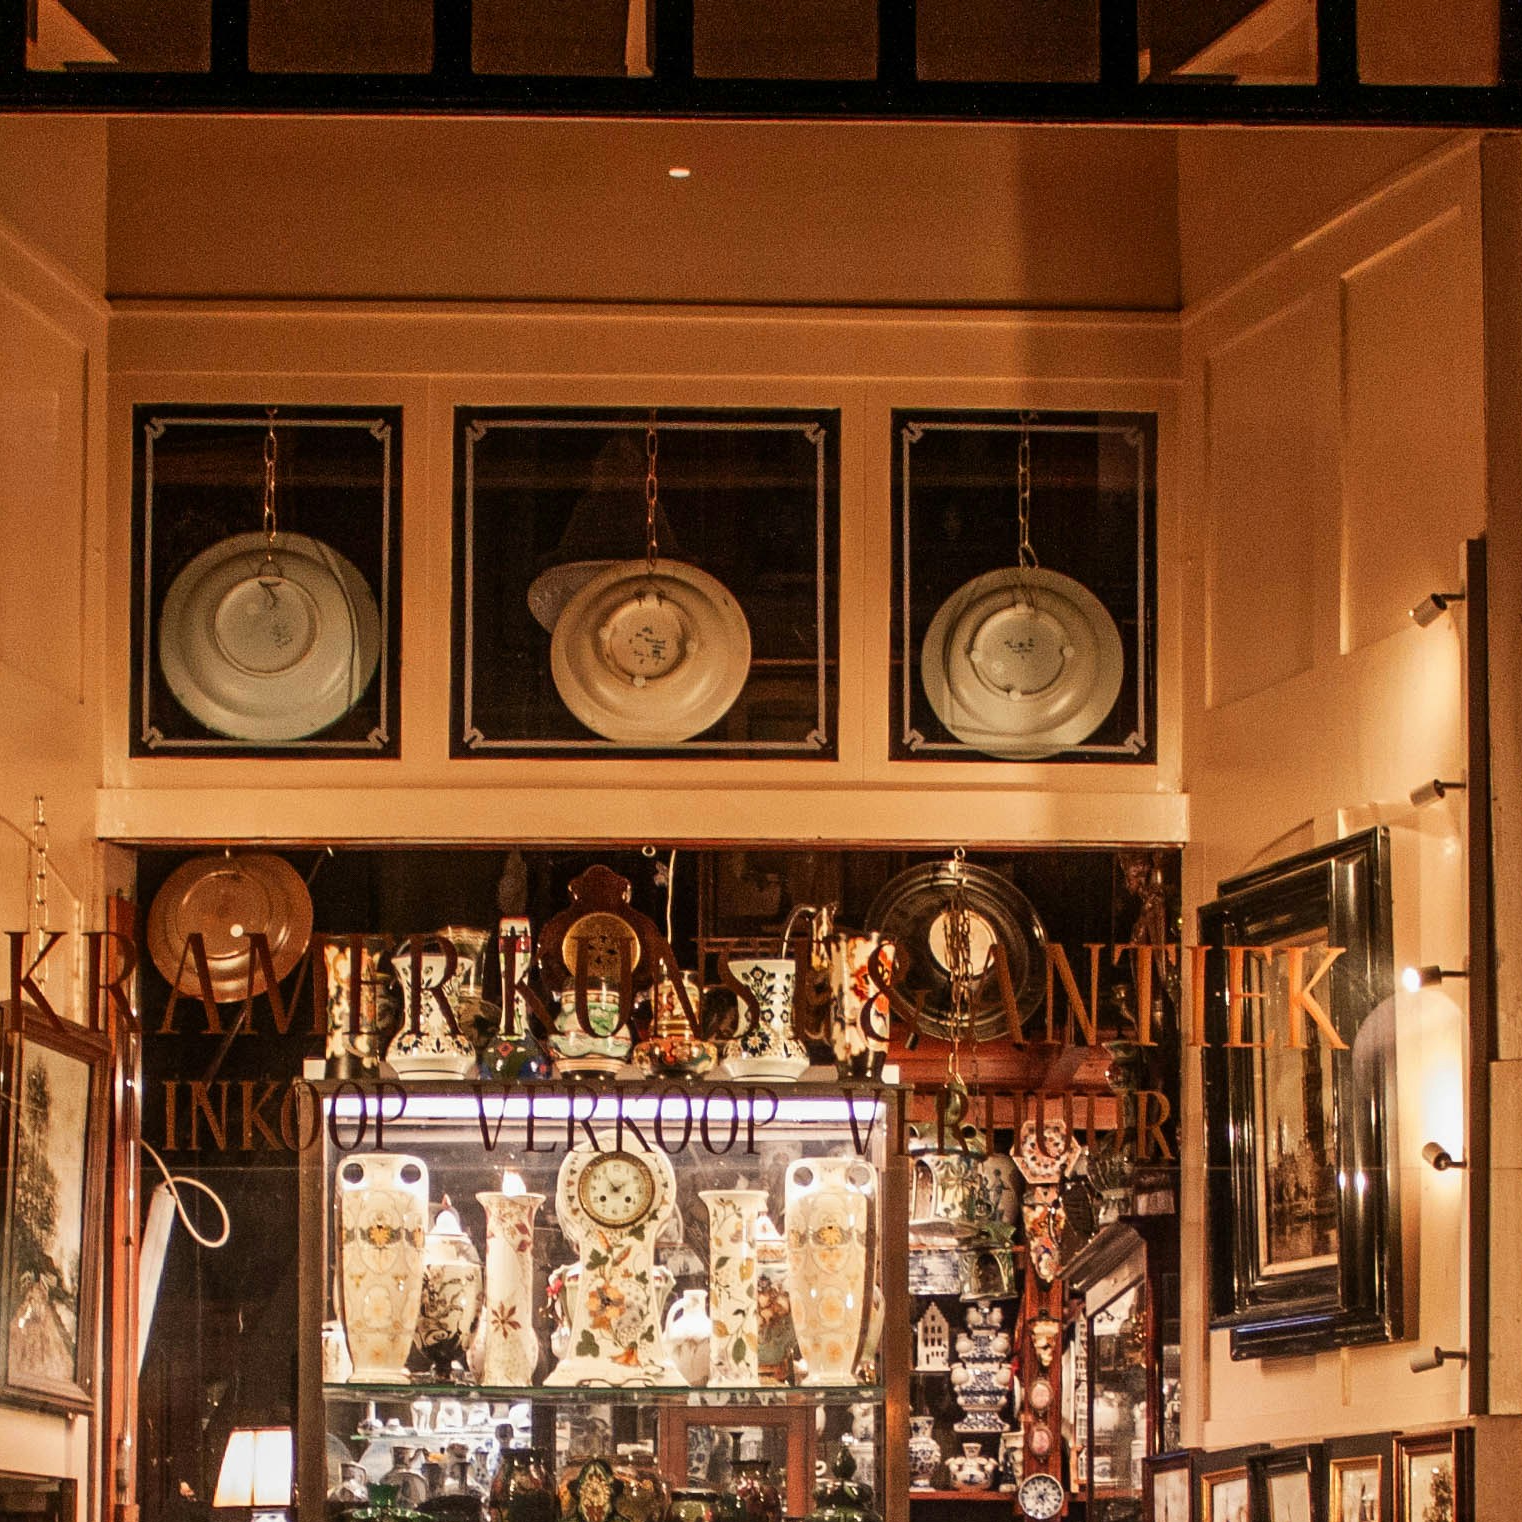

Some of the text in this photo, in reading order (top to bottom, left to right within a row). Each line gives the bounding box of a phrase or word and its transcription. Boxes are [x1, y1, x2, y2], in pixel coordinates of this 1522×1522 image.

[3, 930, 1351, 1050] KRAMER KUNST & ANTIEK
[161, 1079, 408, 1152] INKOOP
[471, 1084, 780, 1155] VERKOOP
